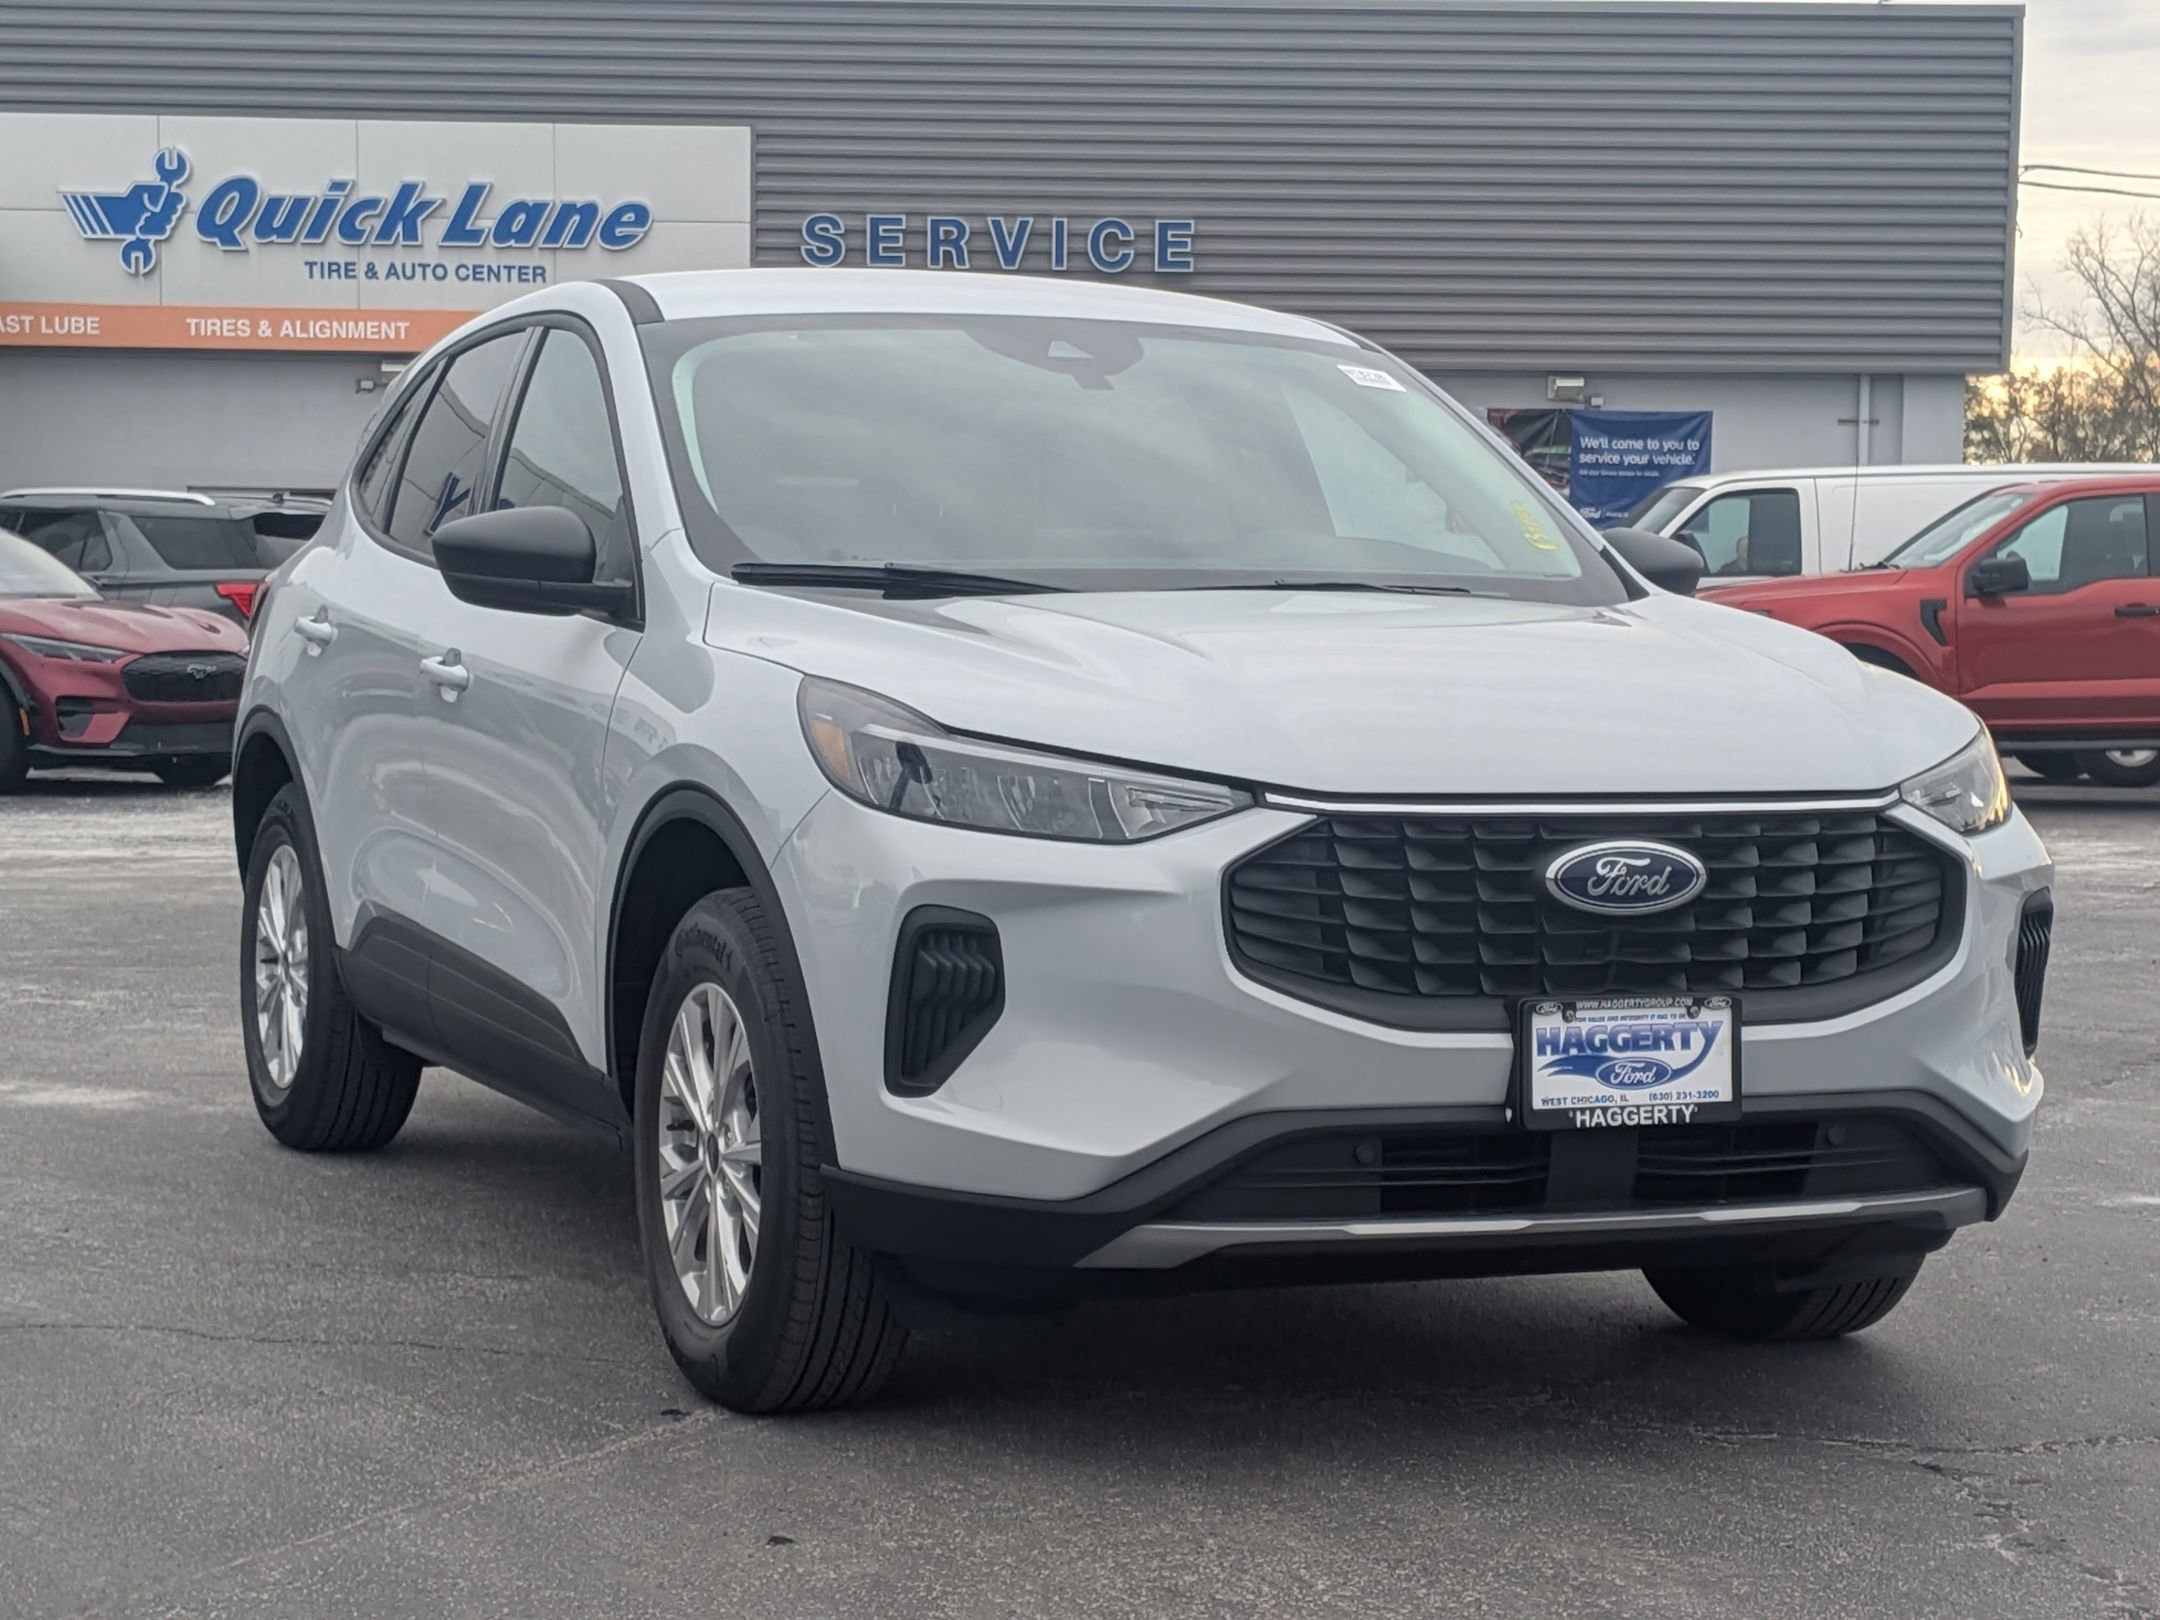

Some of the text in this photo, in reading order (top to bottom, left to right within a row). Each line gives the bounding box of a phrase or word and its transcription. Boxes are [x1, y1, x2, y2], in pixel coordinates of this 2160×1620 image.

[195, 175, 654, 252] Quick Lane
[801, 213, 1195, 273] SERVICE
[304, 262, 547, 283] TIRE & AUTO CENTER
[41, 316, 100, 335] LUBE
[186, 318, 410, 340] TIRES & ALIGNMENT
[1580, 436, 1700, 452] We'll come to you to
[1579, 452, 1620, 465] service
[1622, 453, 1650, 466] your
[1587, 857, 1673, 896] Ford
[1536, 1020, 1724, 1057] HAGGERTY
[1609, 1061, 1657, 1084] Ford
[1541, 1097, 1569, 1106] WEST
[1571, 1095, 1617, 1105] CHICAGO,
[1676, 1090, 1720, 1100] 231-3200
[1576, 1104, 1695, 1128] HAGGERTY
